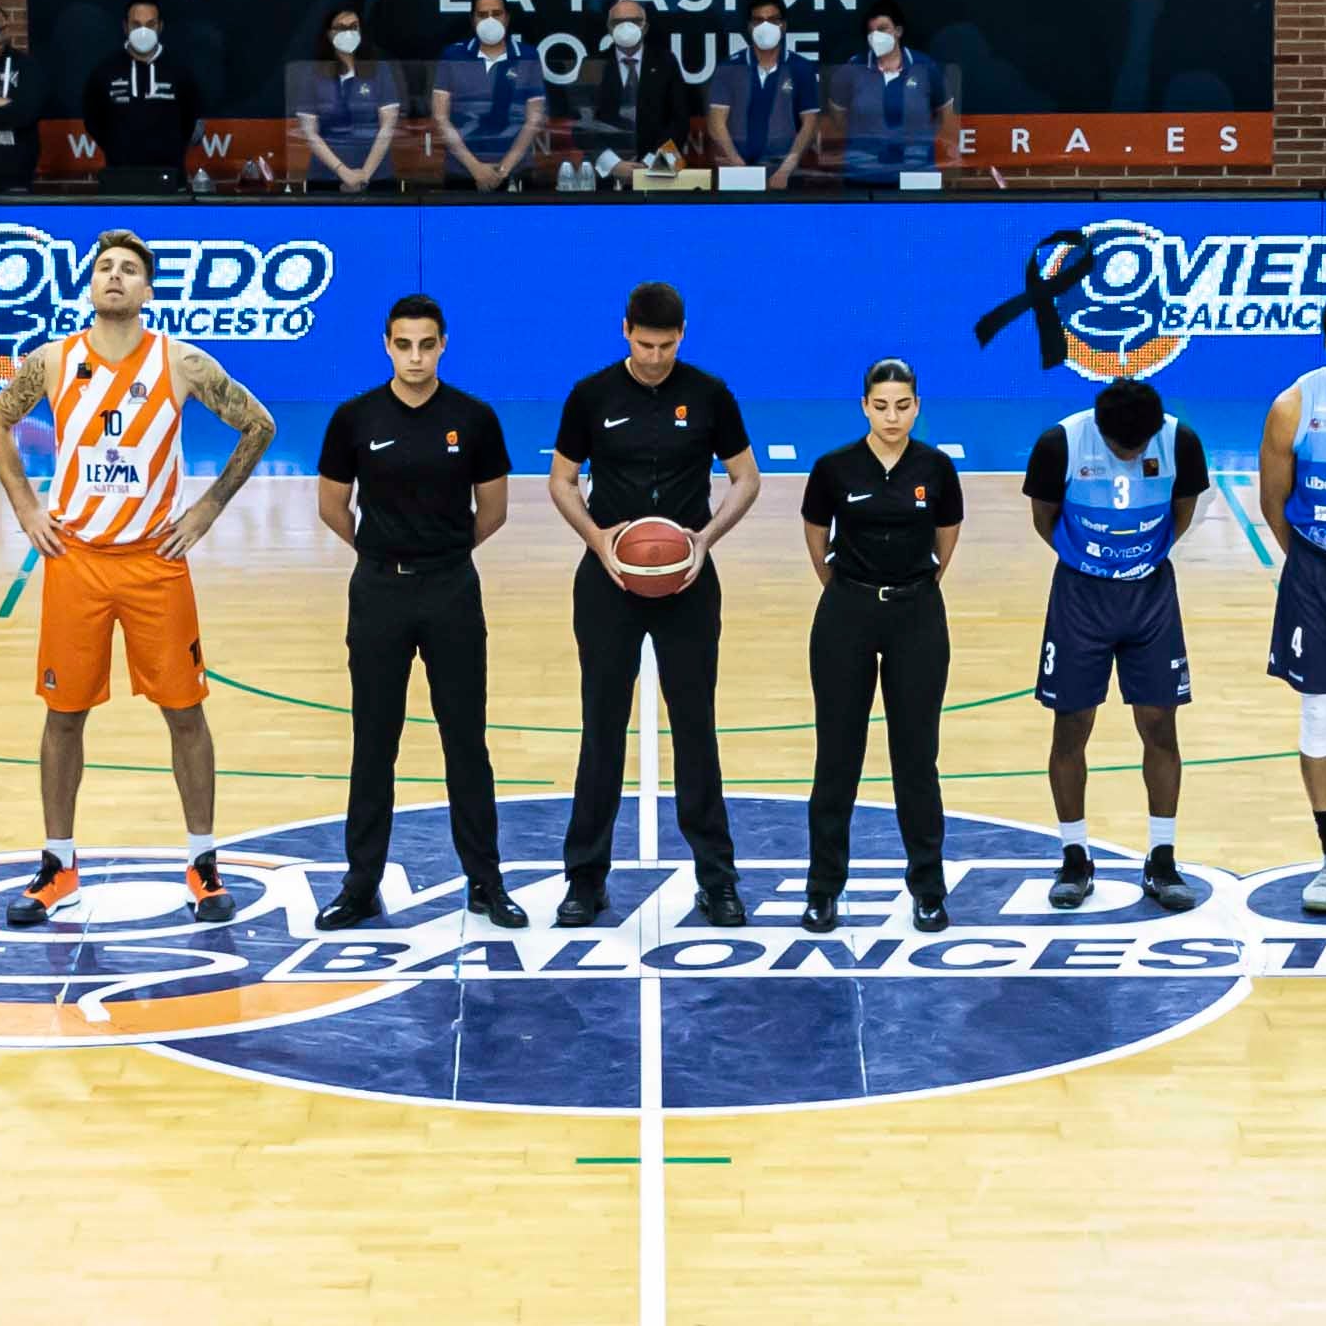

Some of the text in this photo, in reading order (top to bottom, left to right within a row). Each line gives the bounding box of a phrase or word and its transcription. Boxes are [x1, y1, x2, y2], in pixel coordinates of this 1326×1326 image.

[99, 409, 122, 437] 10
[86, 464, 140, 483] LEYMA
[1113, 475, 1131, 510] 3
[1043, 642, 1056, 675] 3
[1291, 626, 1304, 659] 4
